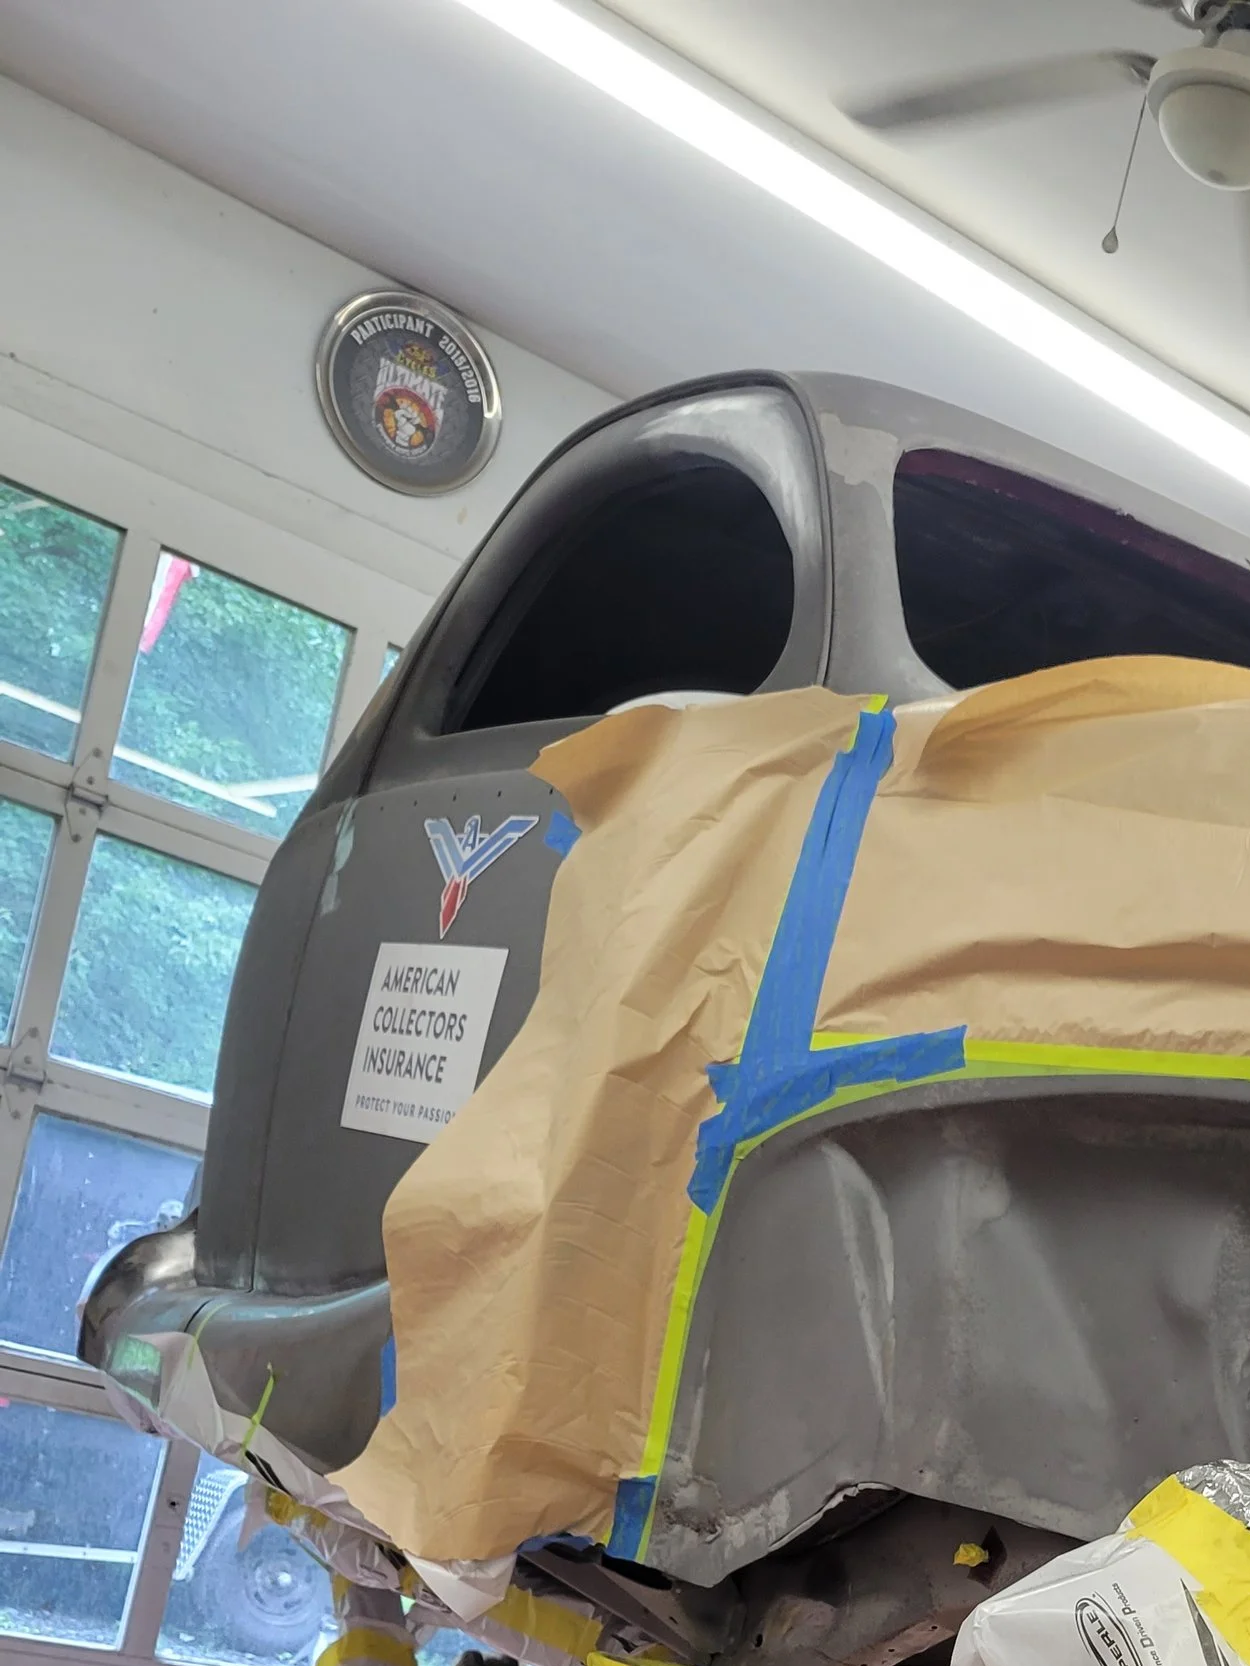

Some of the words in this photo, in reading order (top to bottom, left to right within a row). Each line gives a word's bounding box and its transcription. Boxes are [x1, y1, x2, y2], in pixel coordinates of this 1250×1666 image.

[351, 314, 435, 345] PARTICIPANT
[438, 335, 481, 403] 2015/2016
[381, 965, 460, 997] AMERICAN
[373, 1006, 467, 1042] COLLECTORS
[362, 1046, 447, 1084] INSURANCE
[355, 1094, 390, 1113] PROTECT
[393, 1101, 416, 1117] YOUR
[1112, 1582, 1136, 1616] Products
[1133, 1616, 1154, 1649] Driven
